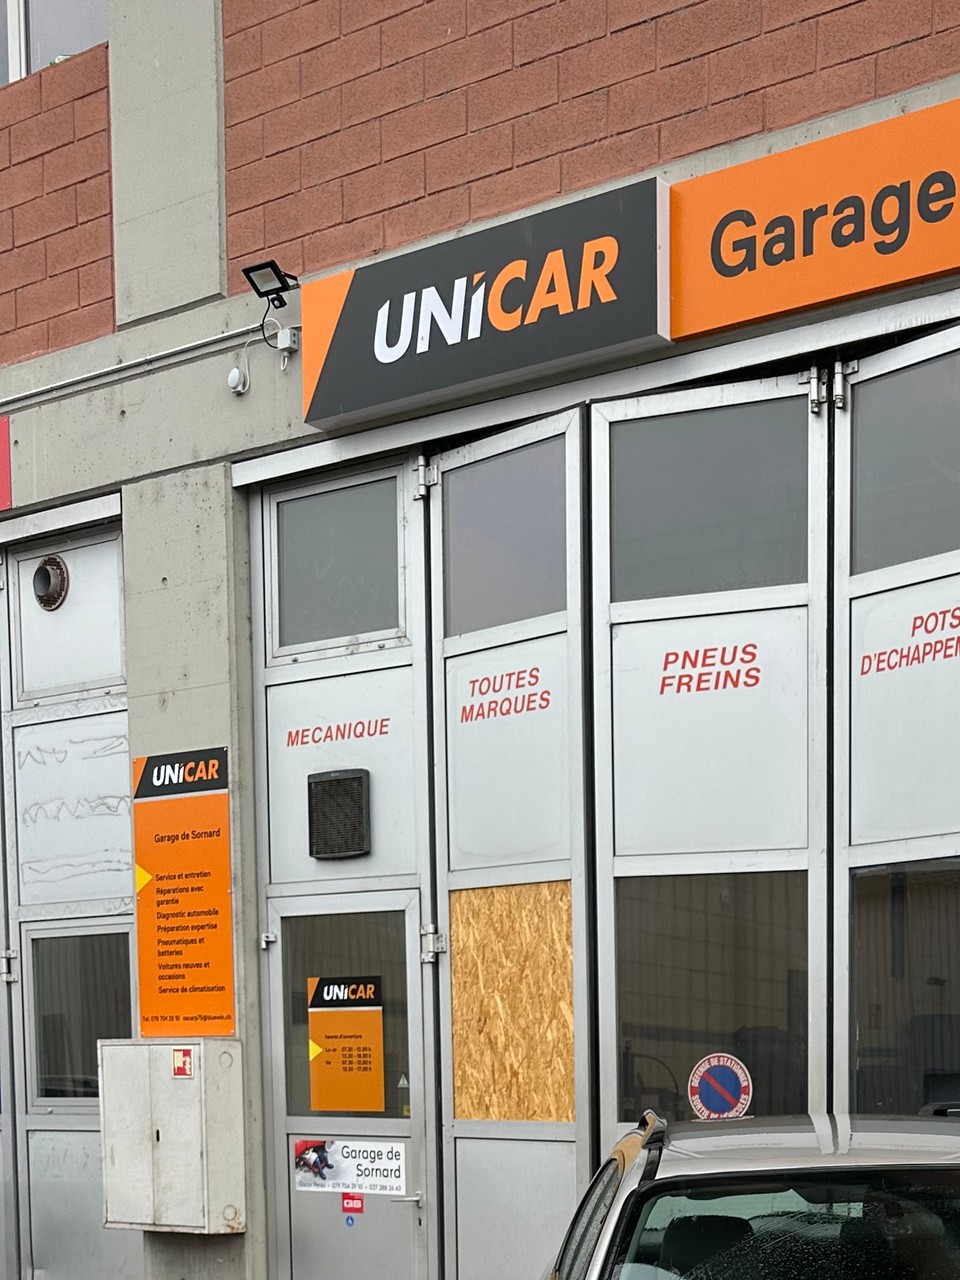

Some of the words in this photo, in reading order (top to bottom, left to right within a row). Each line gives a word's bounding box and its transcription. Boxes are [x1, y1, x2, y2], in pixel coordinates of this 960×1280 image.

[711, 169, 957, 279] Garage
[662, 642, 758, 672] PNEUS
[469, 667, 540, 697] TOUTES
[659, 666, 761, 695] FREINS
[460, 690, 551, 723] MARQUES
[286, 718, 390, 747] MECANIQUE
[154, 833, 180, 844] Garage
[181, 831, 190, 840] de
[191, 828, 220, 839] Sornard
[155, 873, 176, 881] Service
[185, 870, 211, 879] entretien
[156, 897, 179, 908] garantie
[157, 911, 186, 920] Diagnostic
[187, 908, 219, 917] automobile
[191, 923, 218, 932] expertise
[157, 938, 197, 946] Pneumatiques
[158, 962, 181, 970] Voitures
[158, 986, 179, 994] Service
[189, 985, 226, 993] climatisation
[691, 1094, 710, 1119] SORTIE
[342, 1145, 383, 1163] Garage
[387, 1147, 401, 1160] de
[356, 1164, 401, 1178] Sornard
